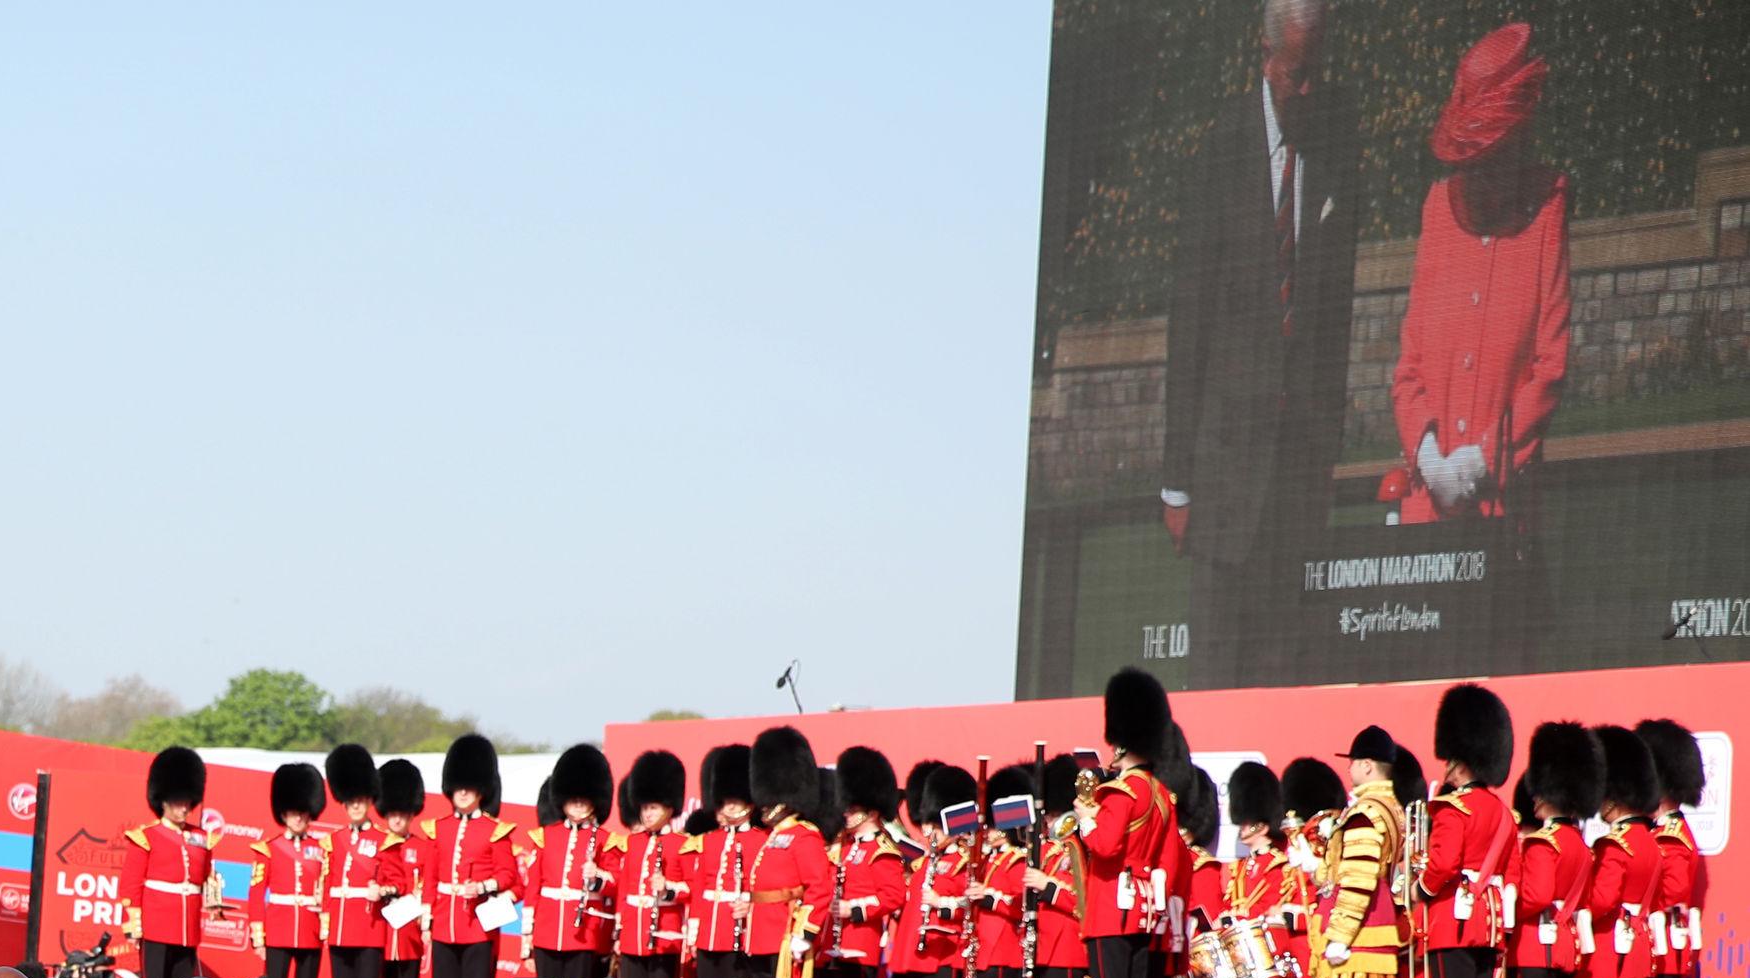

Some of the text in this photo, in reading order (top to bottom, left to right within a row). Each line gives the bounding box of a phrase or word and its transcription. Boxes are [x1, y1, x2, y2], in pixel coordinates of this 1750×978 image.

[1304, 551, 1485, 591] THE LONDON MARATHON 2018
[1339, 601, 1441, 641] #SpiritofLondon
[1142, 624, 1168, 658] THE
[226, 824, 263, 841] money
[57, 871, 118, 899] LON
[73, 899, 122, 926] PRI
